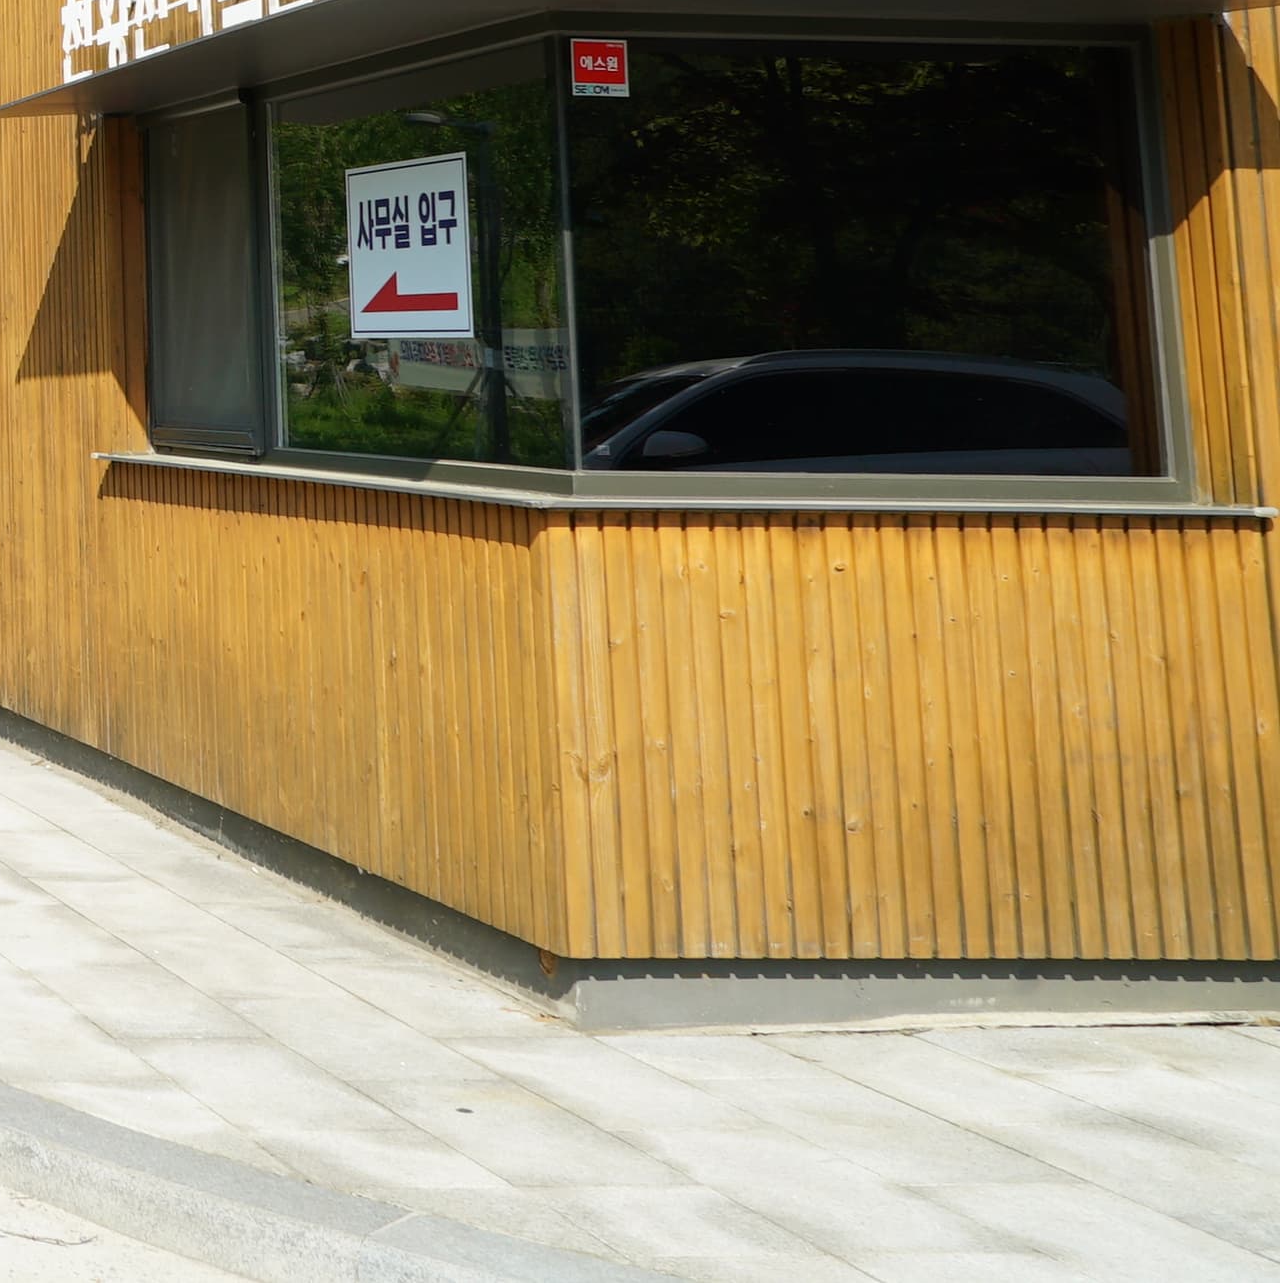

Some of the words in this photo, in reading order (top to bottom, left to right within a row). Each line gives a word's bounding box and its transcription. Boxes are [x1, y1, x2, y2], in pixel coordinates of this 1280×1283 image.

[579, 55, 618, 72] 에스원
[574, 84, 610, 95] SECOM
[357, 194, 411, 251] 사무실
[418, 189, 458, 247] 입구
